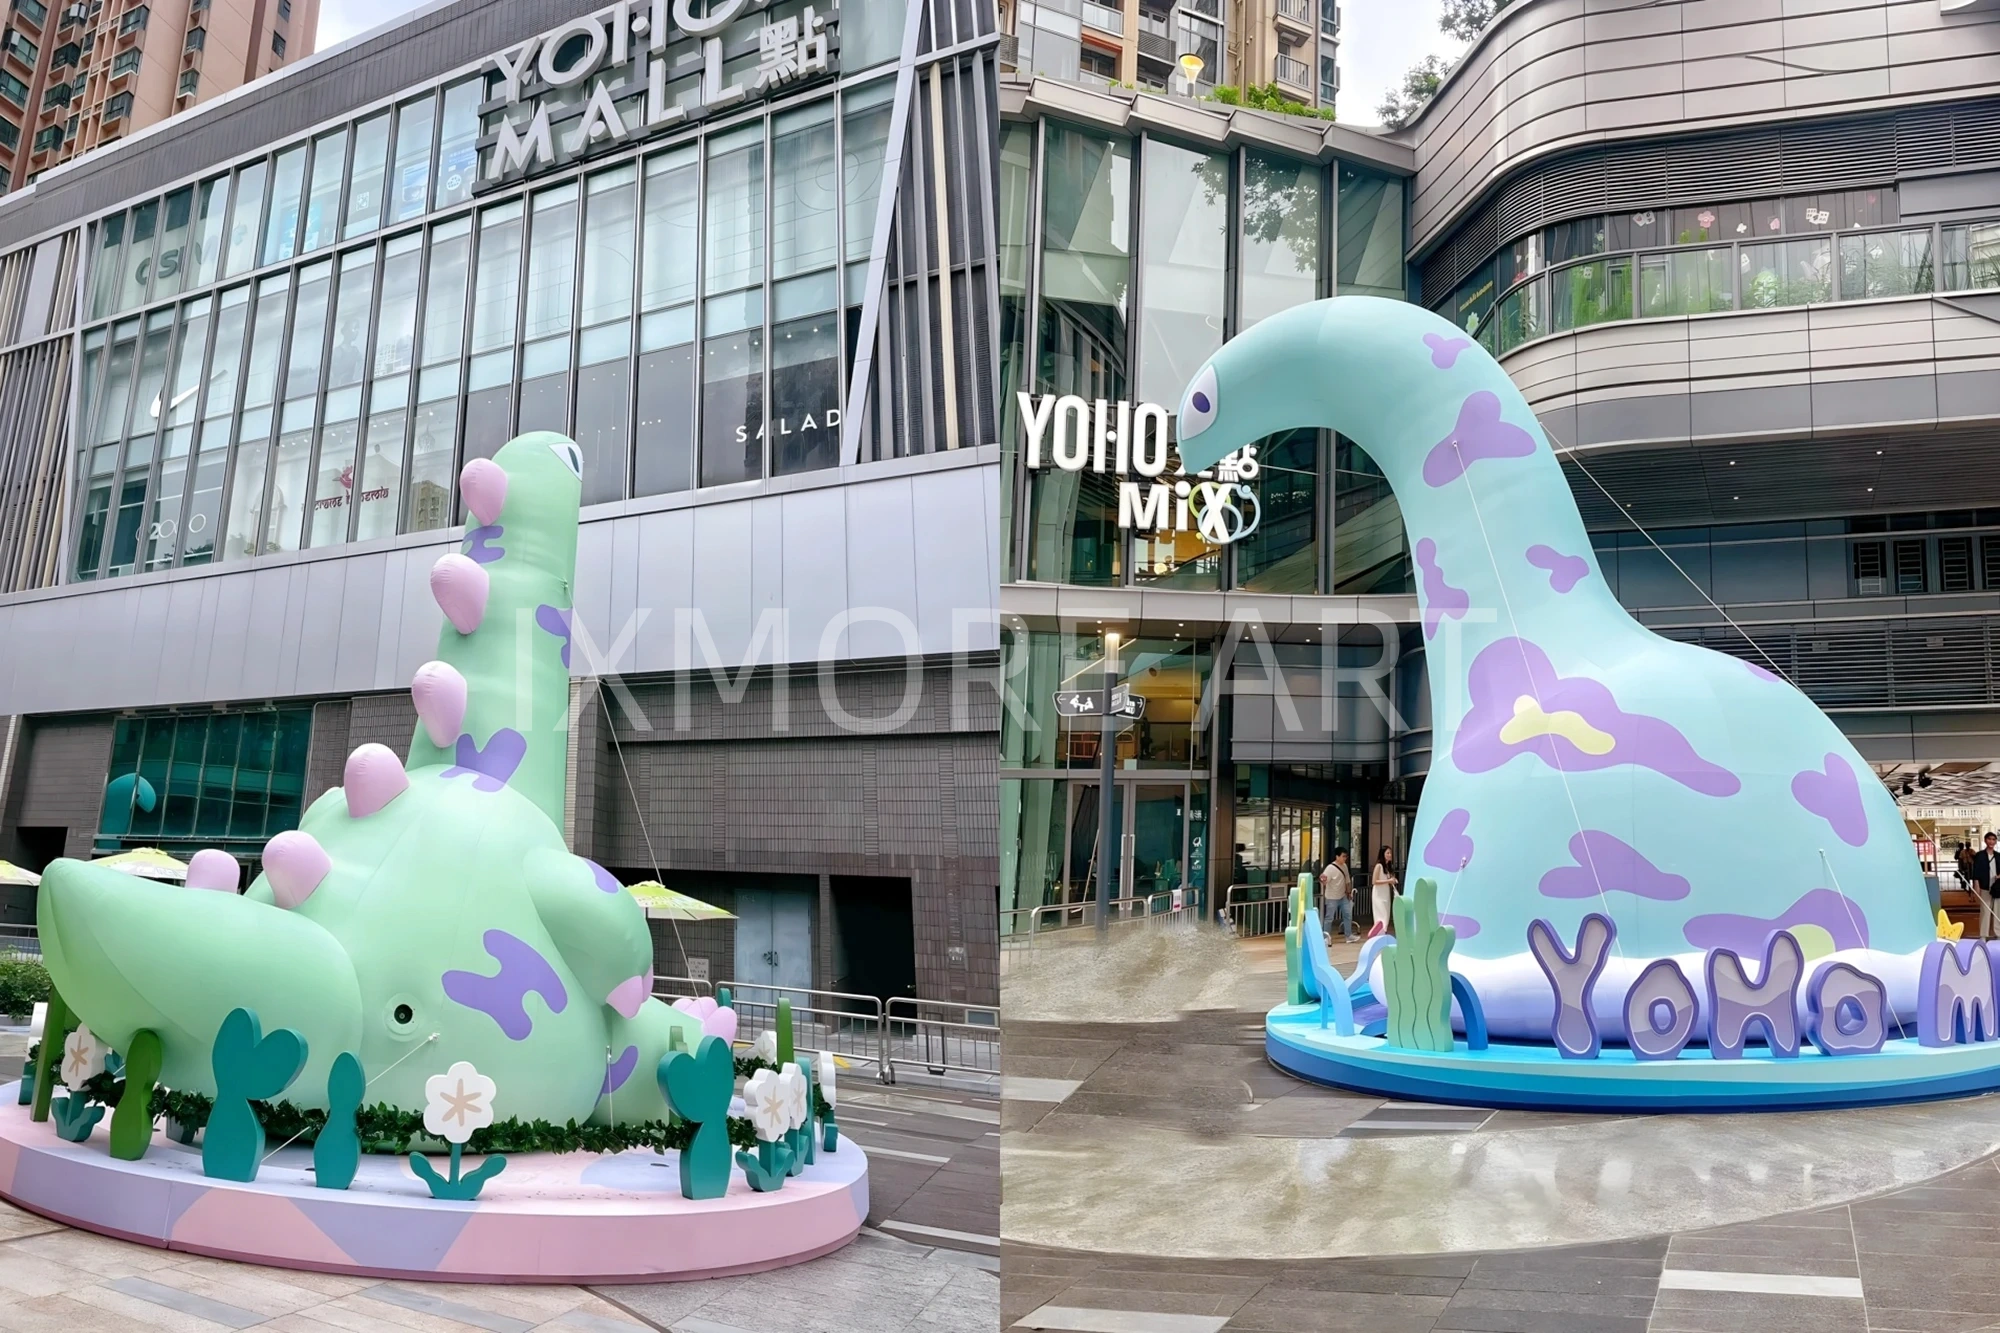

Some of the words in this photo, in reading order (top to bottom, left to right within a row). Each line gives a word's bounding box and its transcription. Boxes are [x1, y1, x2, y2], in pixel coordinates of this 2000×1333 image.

[488, 37, 746, 184] MALL
[1016, 391, 1169, 478] YOHO
[1527, 912, 1887, 1060] YOHO
[1917, 938, 2000, 1049] M
